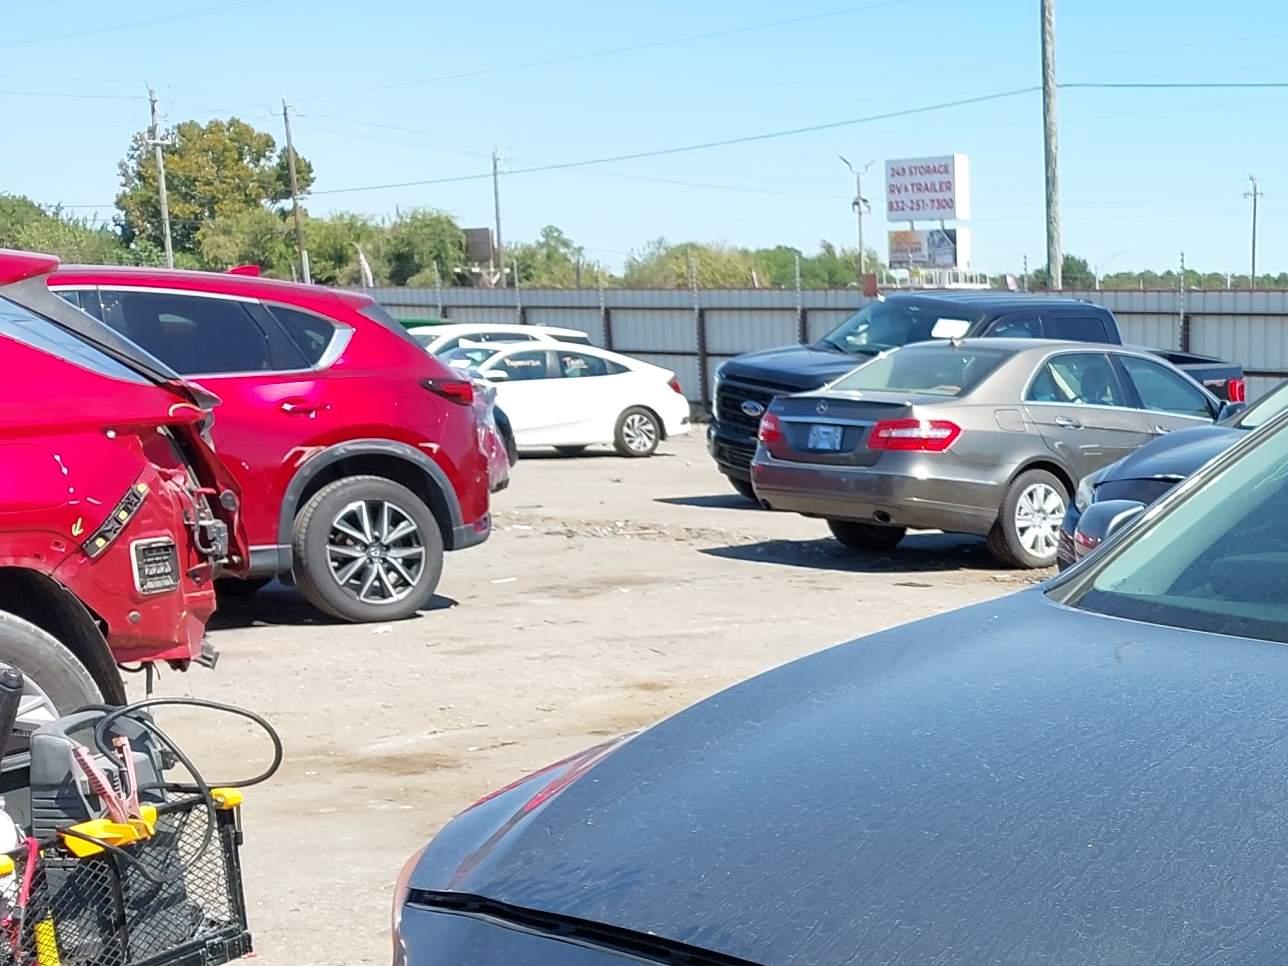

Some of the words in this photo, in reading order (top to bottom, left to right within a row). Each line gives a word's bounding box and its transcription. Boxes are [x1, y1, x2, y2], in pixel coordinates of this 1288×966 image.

[907, 164, 950, 176] STORAGE
[888, 183, 902, 194] RV
[911, 180, 952, 193] TRAILER
